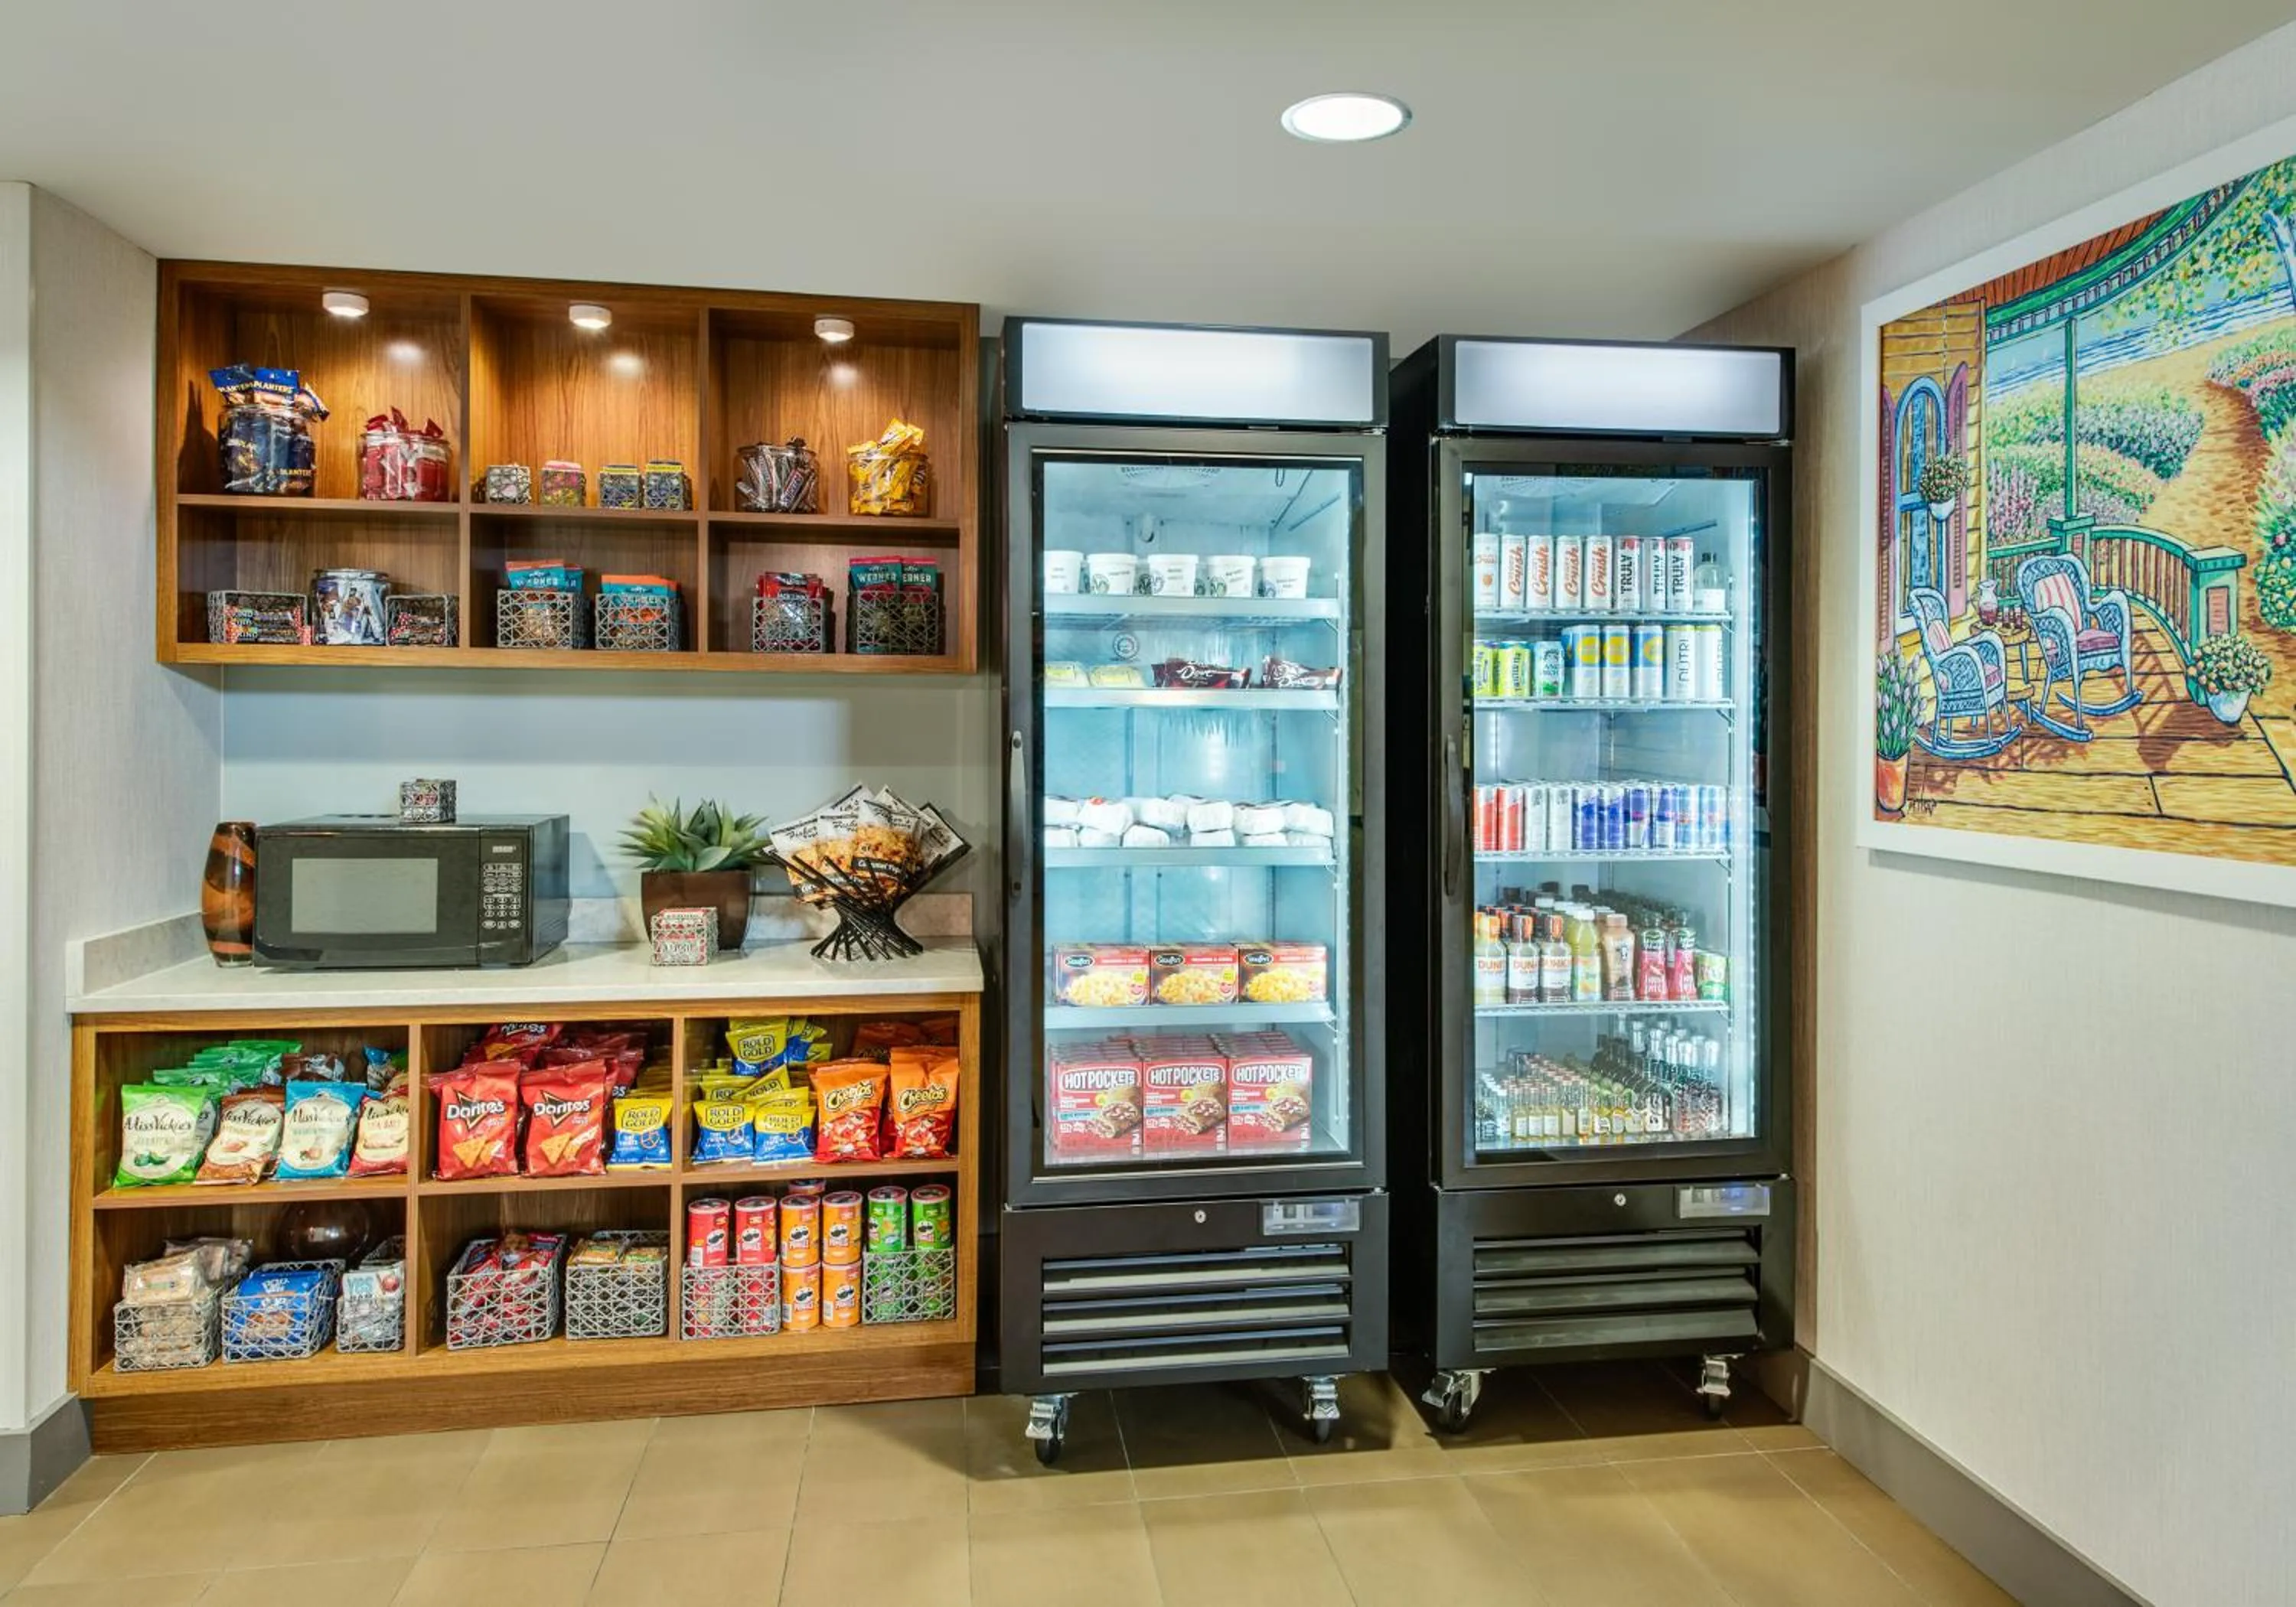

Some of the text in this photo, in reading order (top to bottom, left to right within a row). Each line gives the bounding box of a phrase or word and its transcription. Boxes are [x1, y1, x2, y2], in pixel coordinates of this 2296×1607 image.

[903, 574, 931, 582] ERNER
[1620, 554, 1632, 595] TRULY
[1672, 555, 1684, 595] TRULY
[742, 1036, 771, 1047] ROLD
[742, 1048, 771, 1057] GOLD
[1065, 1071, 1135, 1090] HOT POCKETS
[1151, 1065, 1219, 1086] HOT POCKETS
[1236, 1067, 1259, 1083] HOT
[827, 1081, 874, 1110] Cheetos
[899, 1085, 947, 1110] Cheetos
[446, 1101, 505, 1120] Doritos
[533, 1100, 591, 1116] Doritos
[710, 1107, 740, 1116] ROLD
